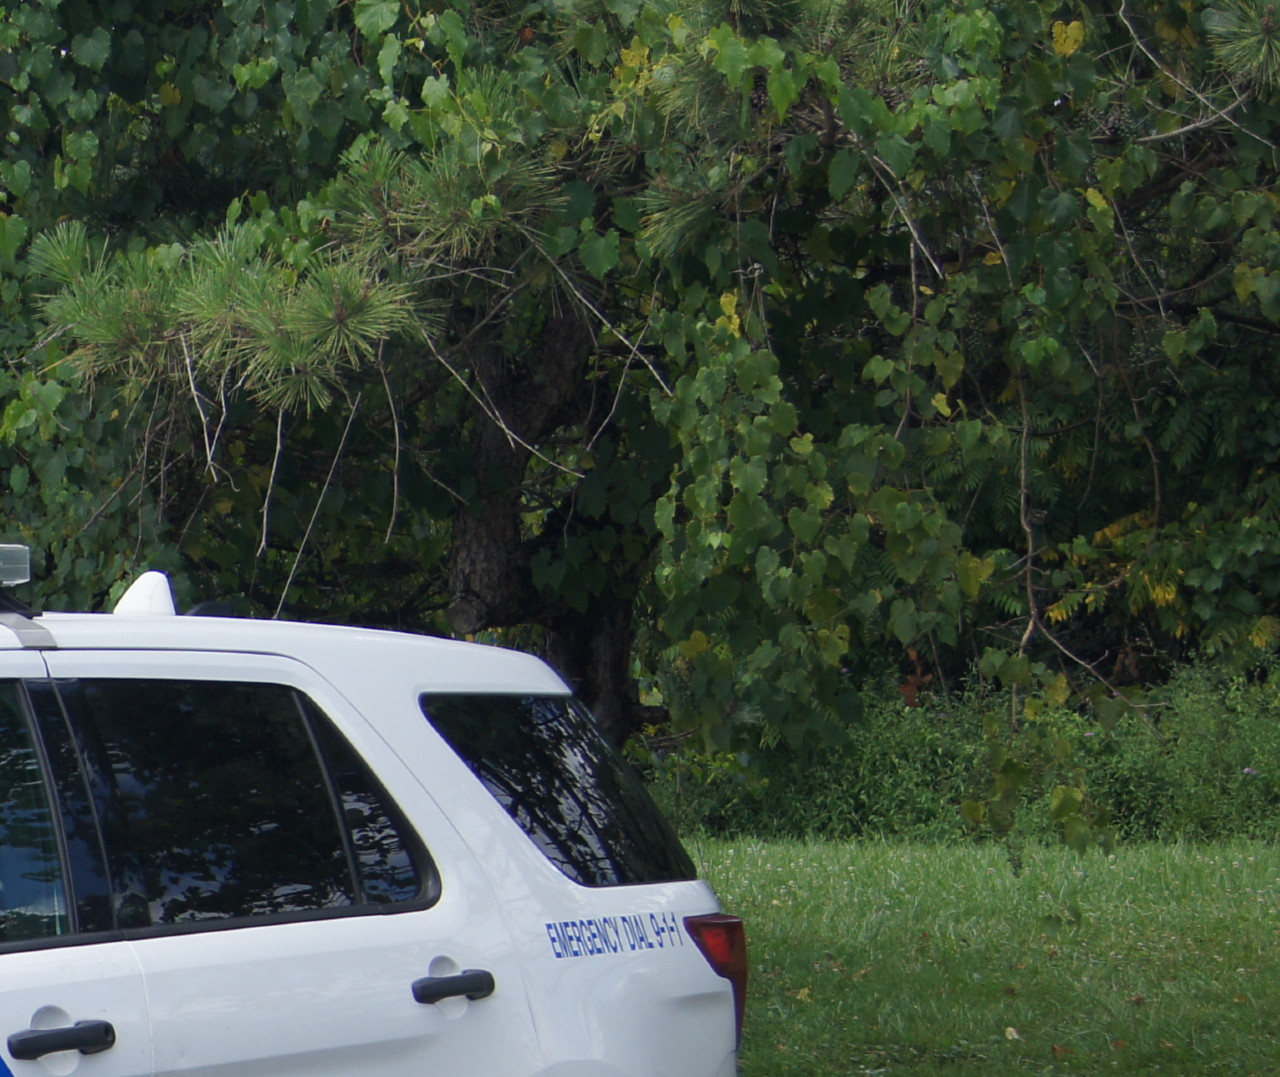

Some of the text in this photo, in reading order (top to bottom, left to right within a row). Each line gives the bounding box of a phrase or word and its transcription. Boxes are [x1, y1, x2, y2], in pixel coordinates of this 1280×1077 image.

[545, 912, 683, 958] EMERGENCY DIAL 9-1-1
